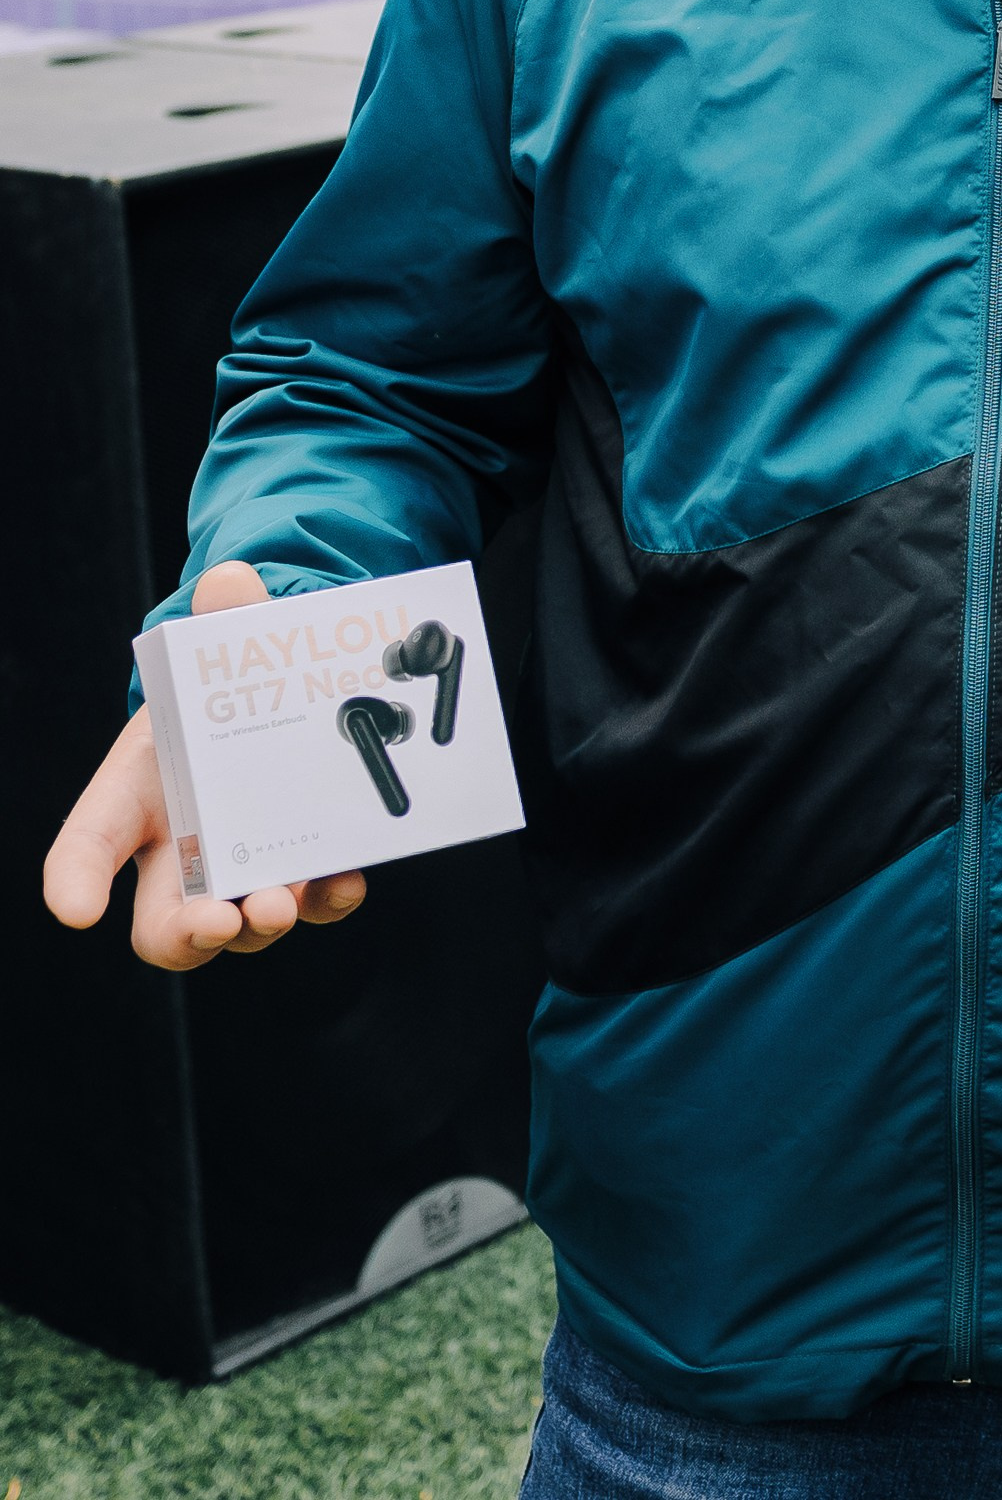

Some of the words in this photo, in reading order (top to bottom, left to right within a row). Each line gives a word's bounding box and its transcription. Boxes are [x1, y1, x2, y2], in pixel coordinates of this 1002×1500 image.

[194, 604, 411, 686] HAYLOU
[204, 677, 287, 724] GT7
[302, 664, 388, 704] Neo
[209, 730, 230, 742] True
[231, 722, 270, 737] Wireless
[271, 713, 308, 728] Earbuds
[255, 831, 320, 853] HAYLOU
